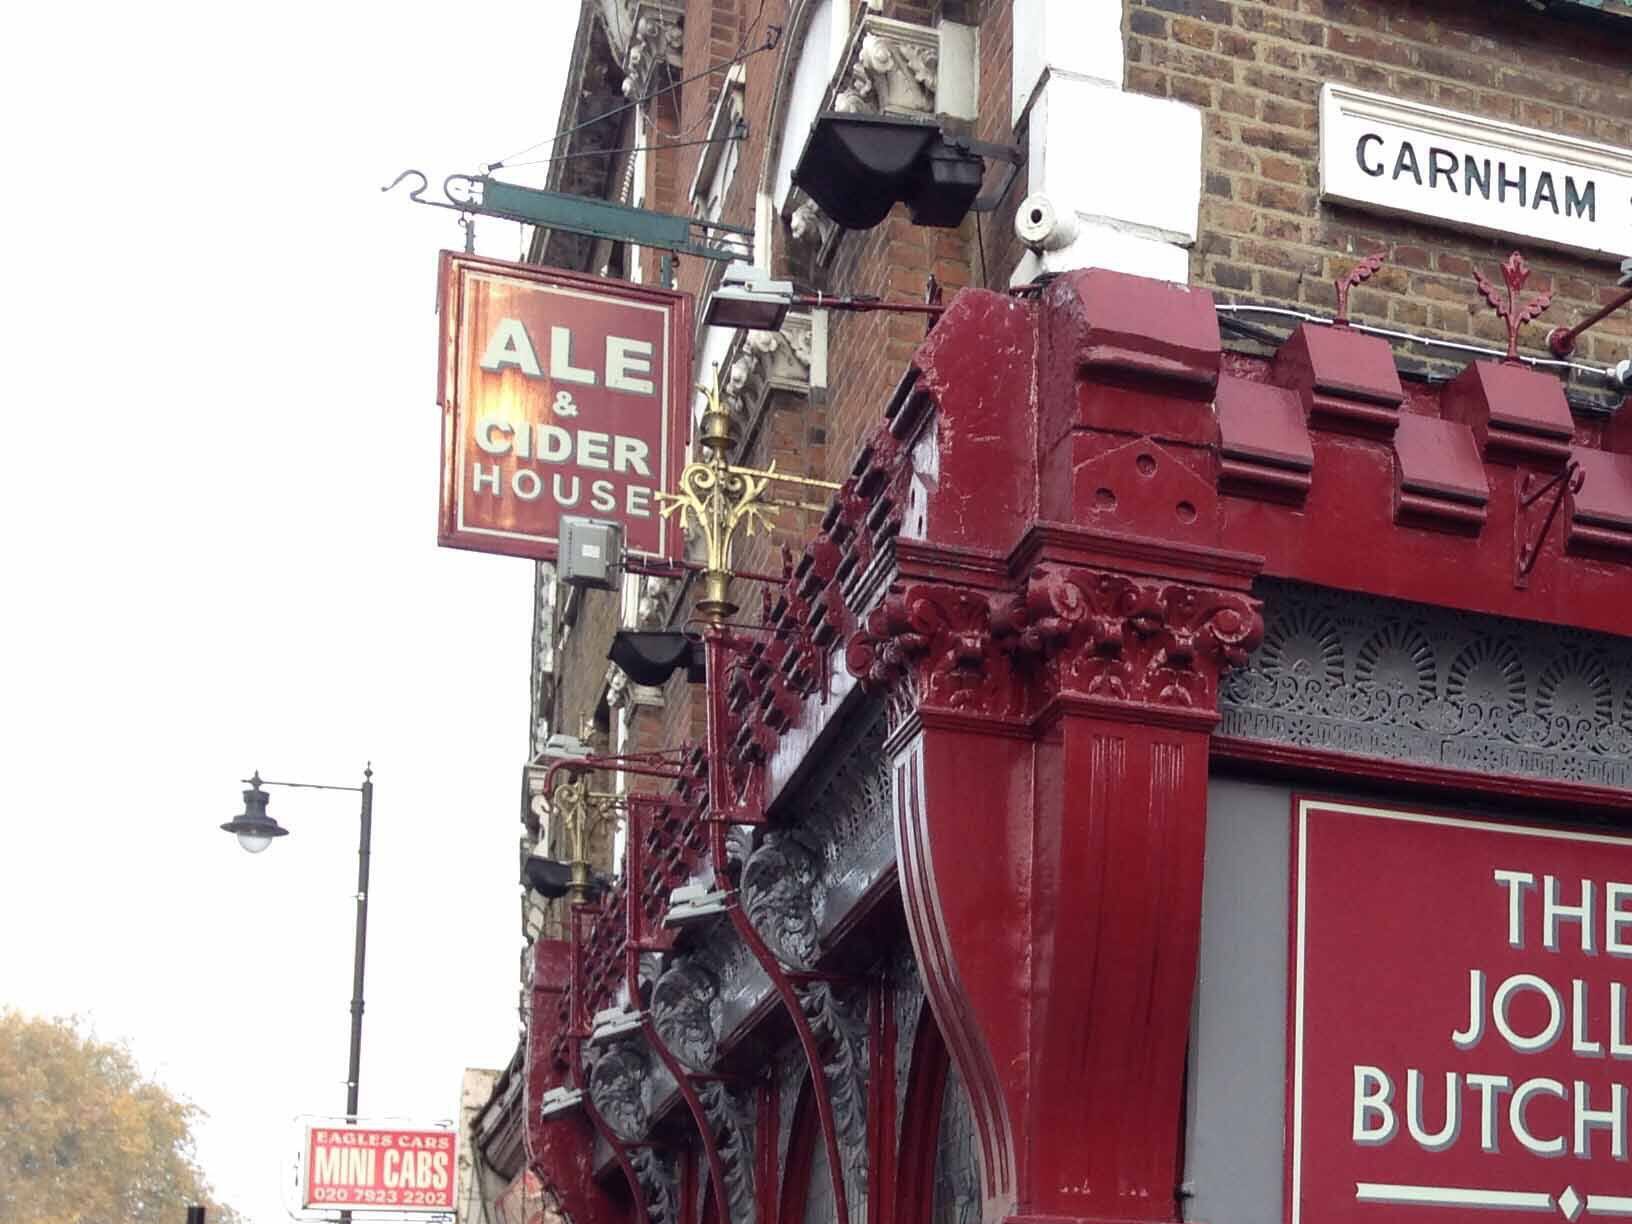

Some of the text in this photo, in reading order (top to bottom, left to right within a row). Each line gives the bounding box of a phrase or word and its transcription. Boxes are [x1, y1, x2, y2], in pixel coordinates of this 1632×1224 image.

[1356, 132, 1597, 223] GARNHAM
[480, 317, 654, 395] ALE
[552, 390, 579, 417] &
[475, 416, 651, 477] CIDER
[471, 462, 652, 518] HOUSE
[316, 1131, 449, 1149] EAGLES CARS
[314, 1147, 449, 1191] MINI CABS
[314, 1187, 348, 1200] 020
